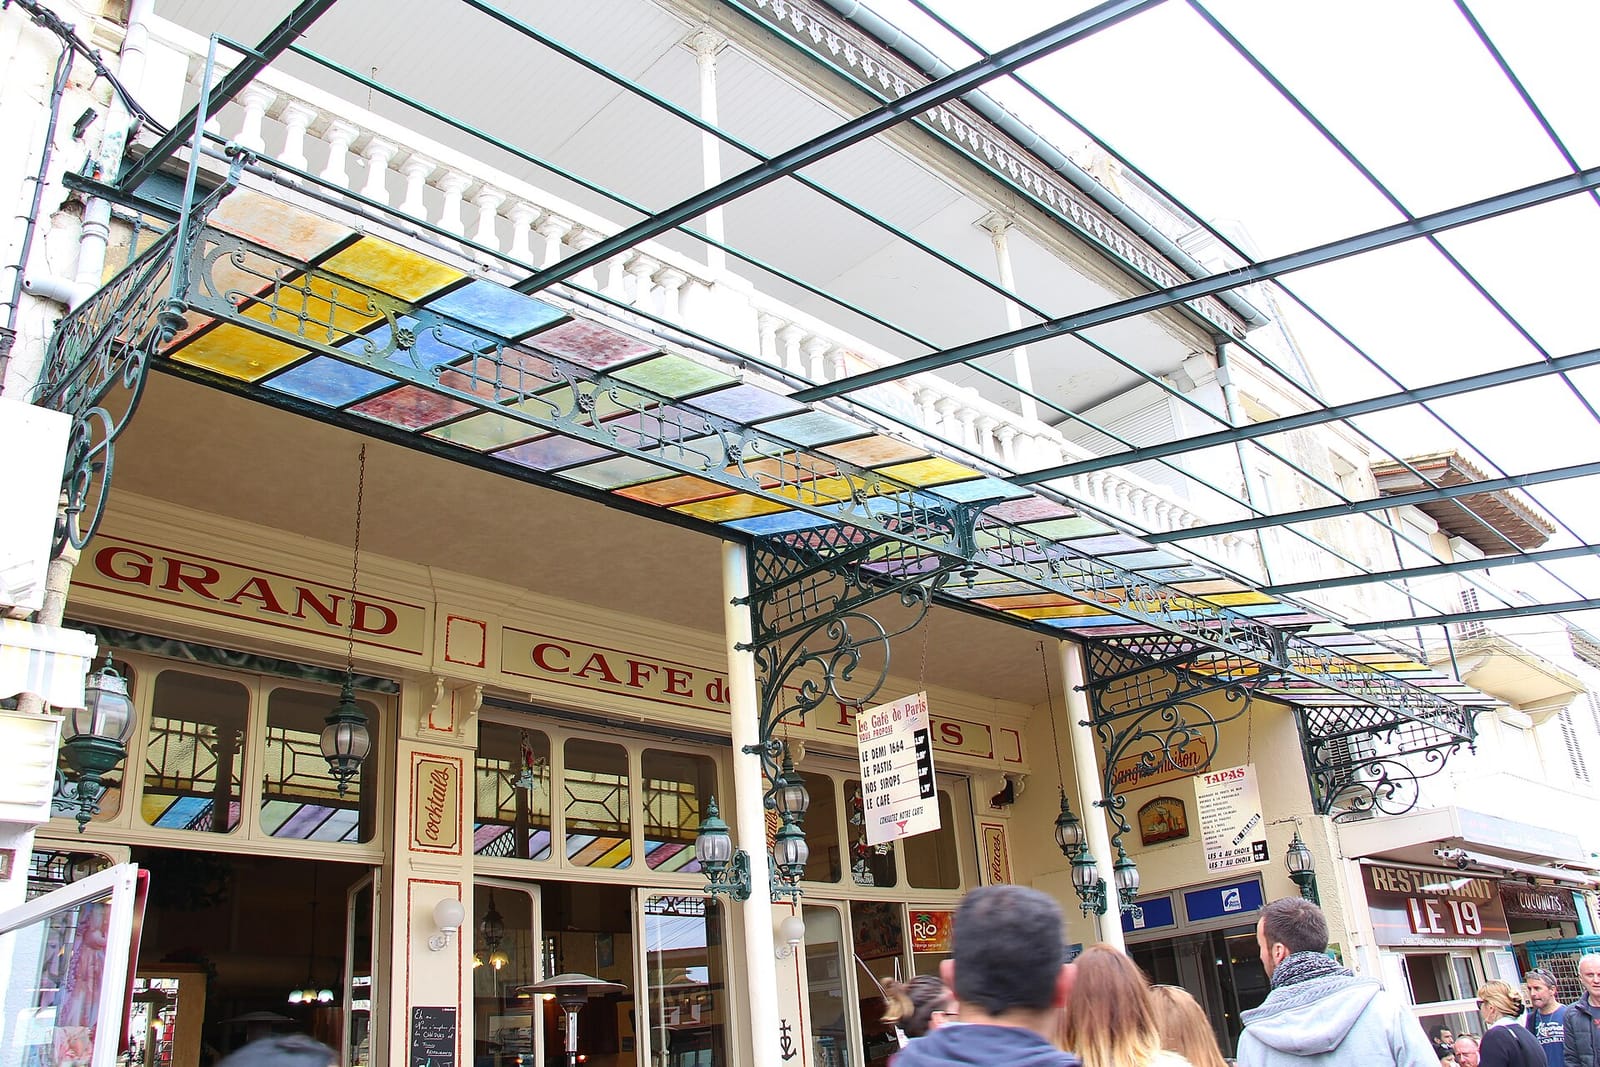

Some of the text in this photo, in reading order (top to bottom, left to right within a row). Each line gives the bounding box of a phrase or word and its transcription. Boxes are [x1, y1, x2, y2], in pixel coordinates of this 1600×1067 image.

[94, 547, 398, 635] GRAND
[532, 642, 694, 698] CAFE
[892, 708, 902, 722] de
[904, 699, 927, 718] Paris
[872, 724, 894, 737] PROPOSE
[861, 750, 869, 763] LE
[871, 744, 887, 760] DEMI
[889, 739, 904, 755] 1664
[863, 760, 893, 778] LE PASTIS
[1204, 768, 1245, 785] TAPAS
[864, 774, 901, 794] NOS SIROPS
[425, 767, 450, 841] cocktails
[866, 793, 891, 810] LE CAFE
[992, 833, 1003, 882] glaces
[1234, 847, 1250, 856] CHOIX
[1208, 861, 1218, 870] LES
[1235, 855, 1251, 865] CHOIX
[1407, 897, 1483, 935] LE 19
